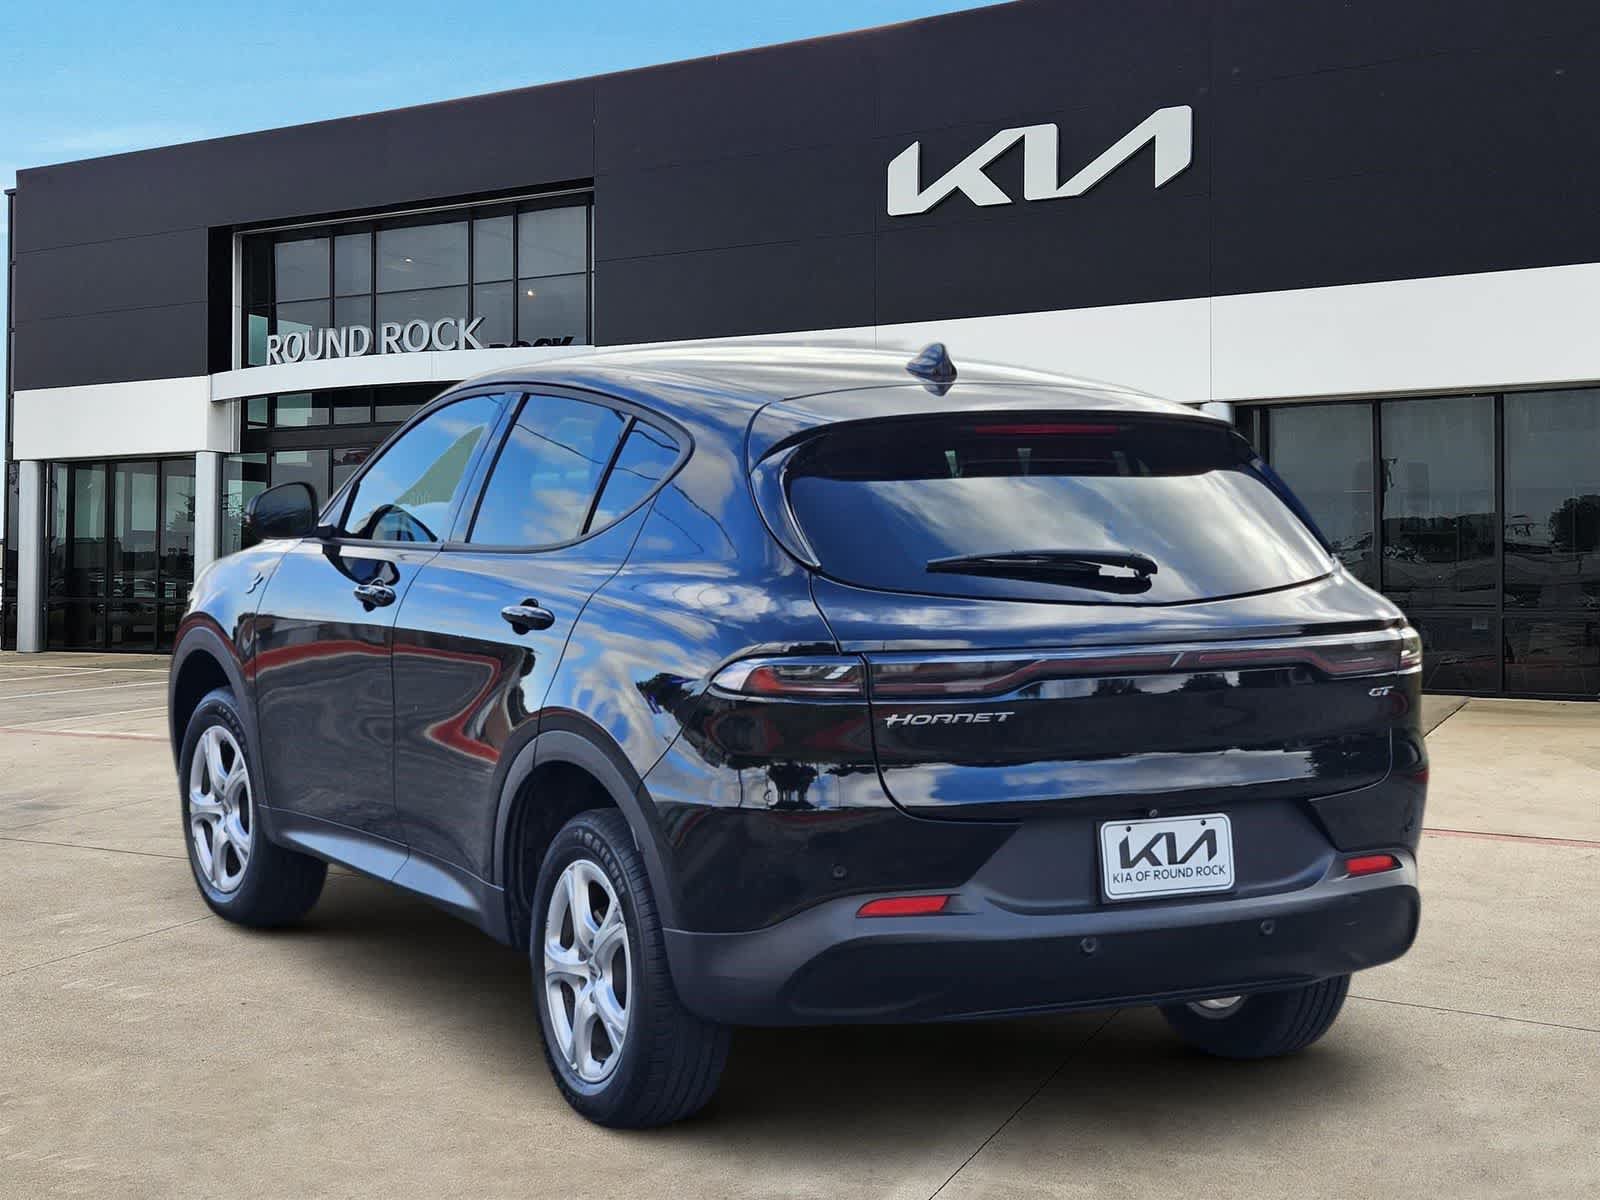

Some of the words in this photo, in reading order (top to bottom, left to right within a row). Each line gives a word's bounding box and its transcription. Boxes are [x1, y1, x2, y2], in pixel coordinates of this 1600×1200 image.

[887, 105, 1192, 216] KIA
[265, 324, 372, 366] ROUND
[380, 316, 486, 354] ROCK
[1368, 685, 1394, 697] GT
[884, 711, 1015, 728] HORNET
[1119, 828, 1217, 869] KIA
[1112, 872, 1133, 884] KIA
[1135, 870, 1151, 882] OF
[1153, 867, 1194, 880] ROUND
[1196, 864, 1226, 877] ROCK
